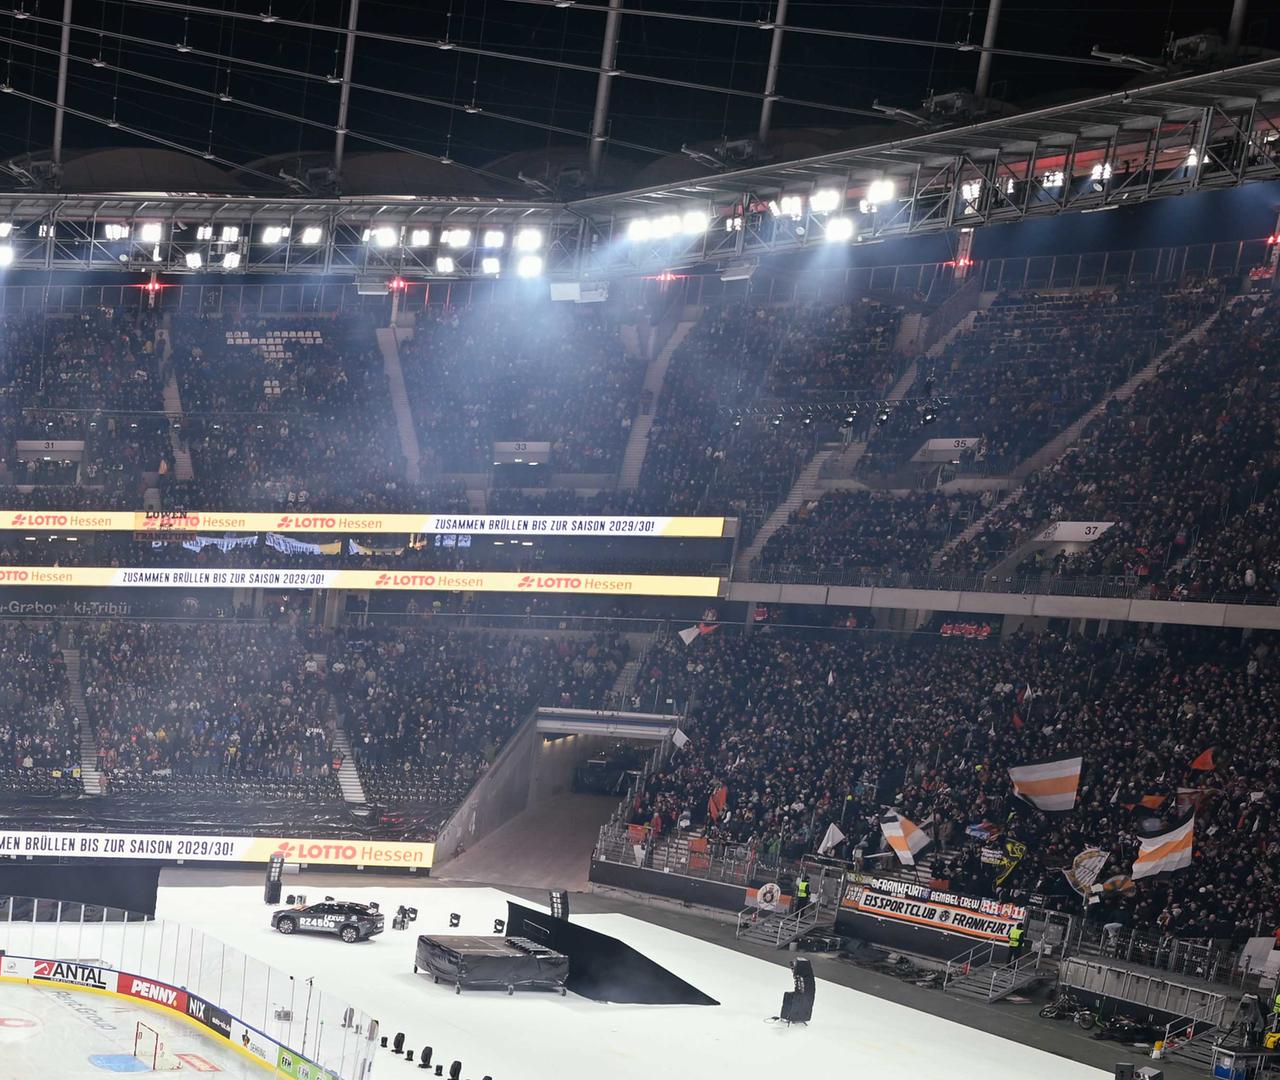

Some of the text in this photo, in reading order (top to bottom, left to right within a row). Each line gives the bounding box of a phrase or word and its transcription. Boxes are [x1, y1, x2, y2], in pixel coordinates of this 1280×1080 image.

[515, 443, 527, 451] 33
[954, 440, 967, 448] 35
[28, 515, 111, 526] LOTTO Hessen
[1084, 526, 1098, 535] 37
[298, 845, 423, 862] LOTTO Hessen
[863, 895, 1015, 937] EISSPORTCLUB FRANKFURT
[52, 962, 107, 984] ANTAL
[189, 997, 205, 1020] NIX
